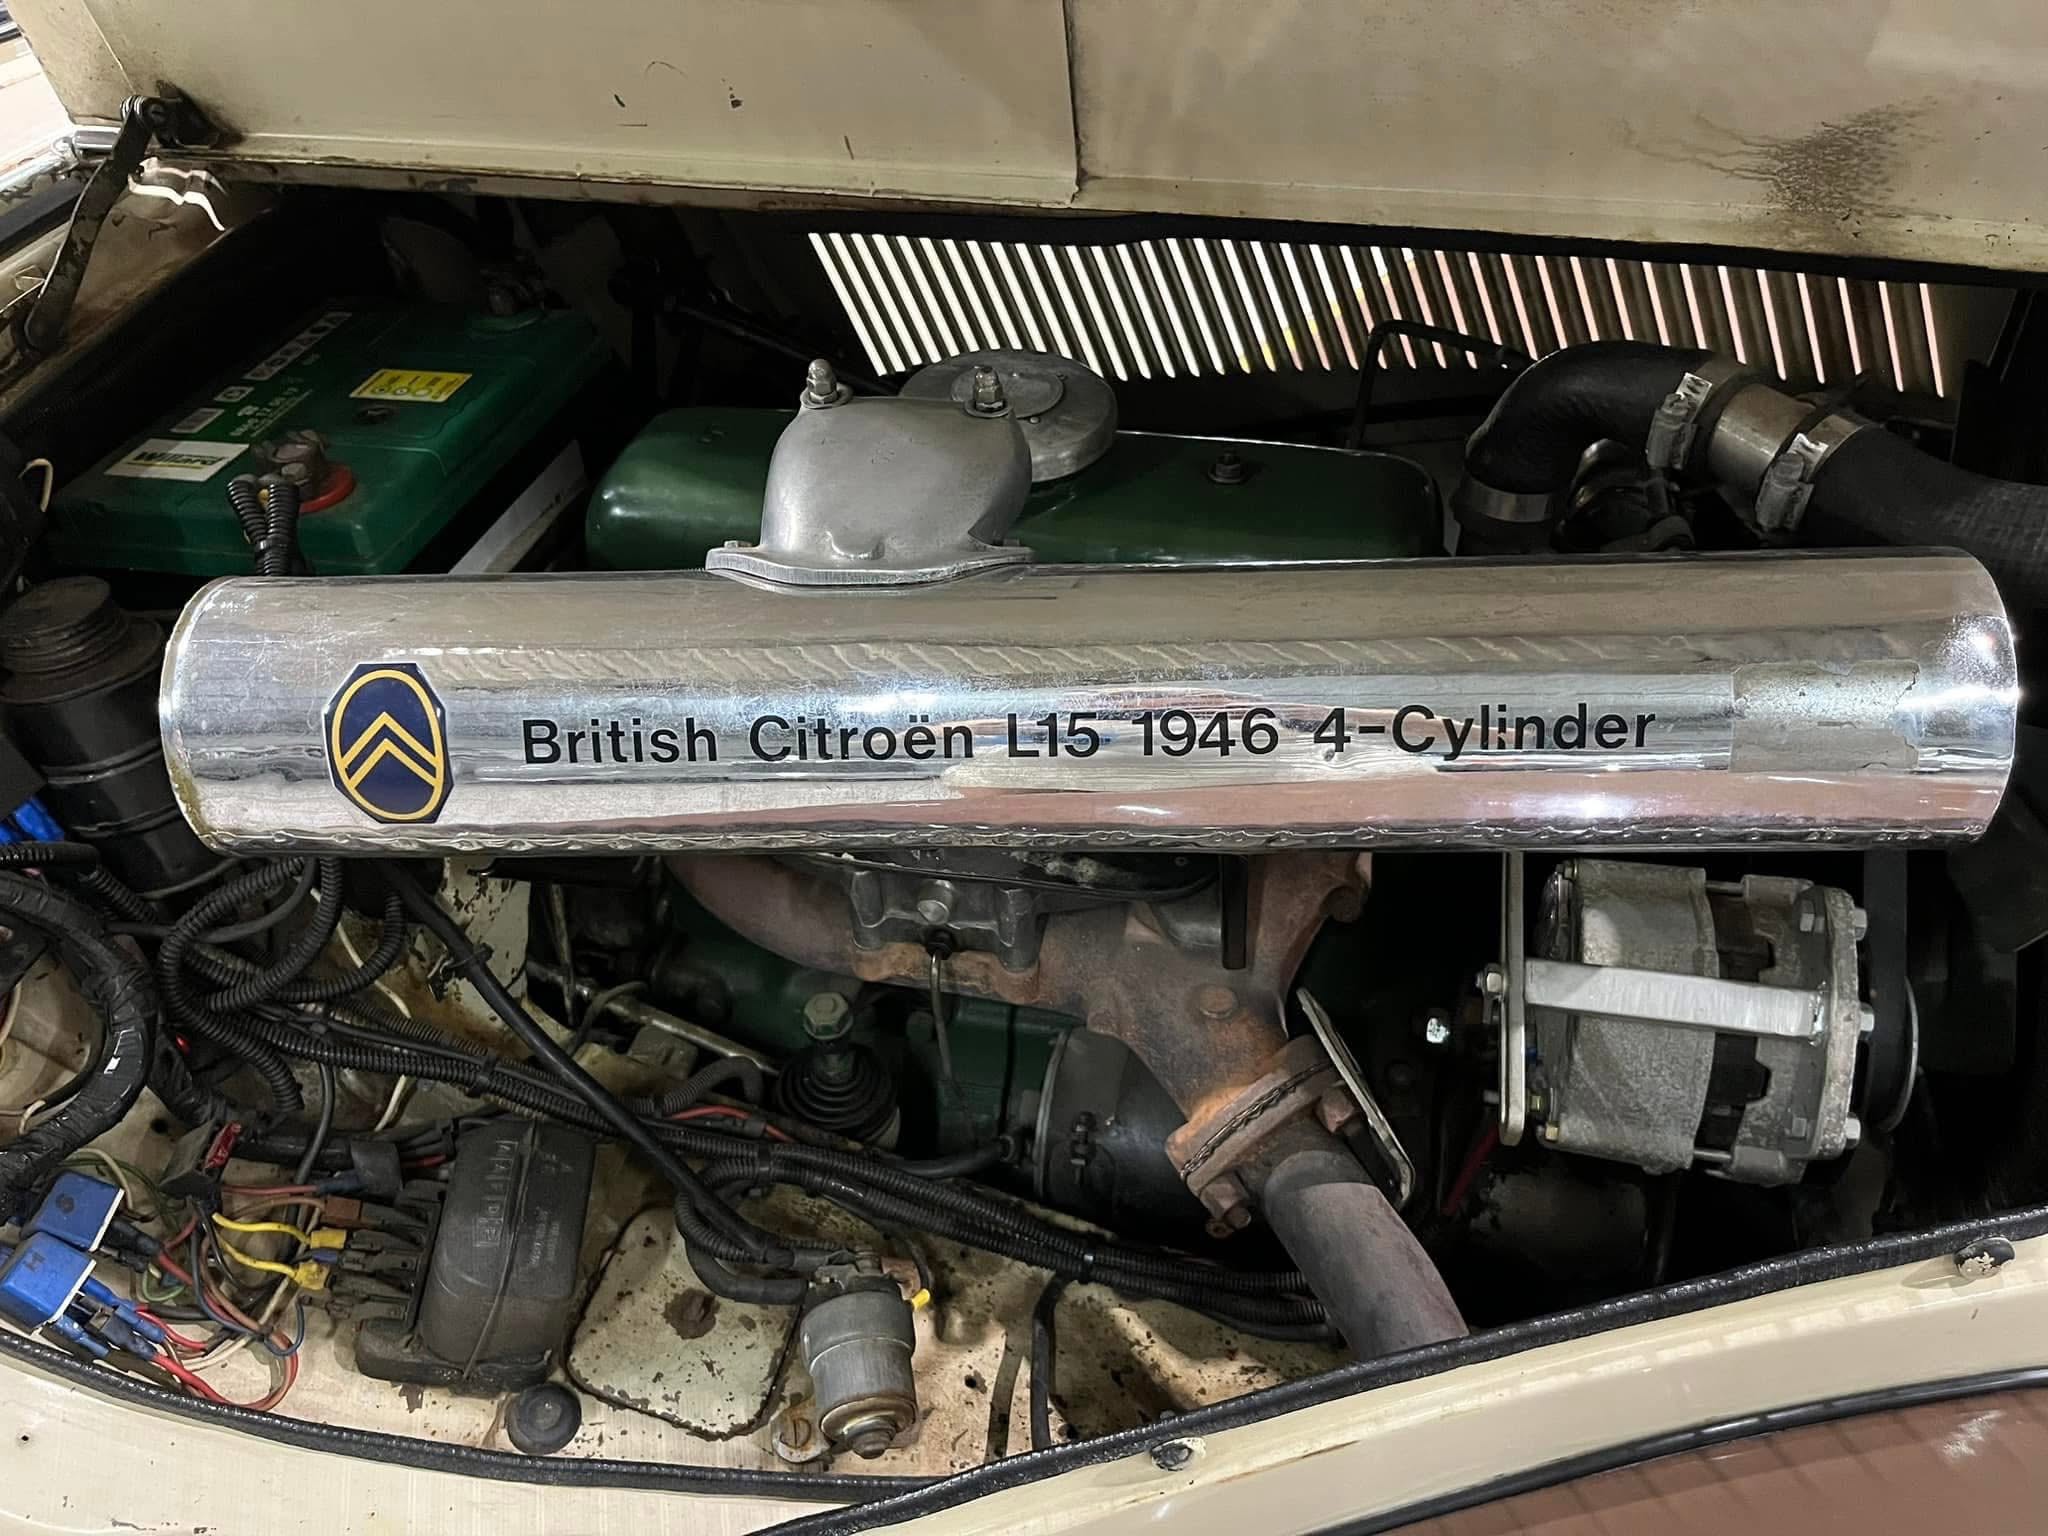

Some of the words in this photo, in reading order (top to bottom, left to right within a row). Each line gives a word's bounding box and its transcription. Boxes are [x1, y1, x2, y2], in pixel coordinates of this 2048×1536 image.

[132, 452, 229, 466] Willard
[522, 717, 718, 765] British
[749, 713, 974, 761] Citroën
[1007, 711, 1099, 758] L15
[1131, 707, 1279, 757] 1946
[1313, 702, 1656, 761] 4-Cylinder
